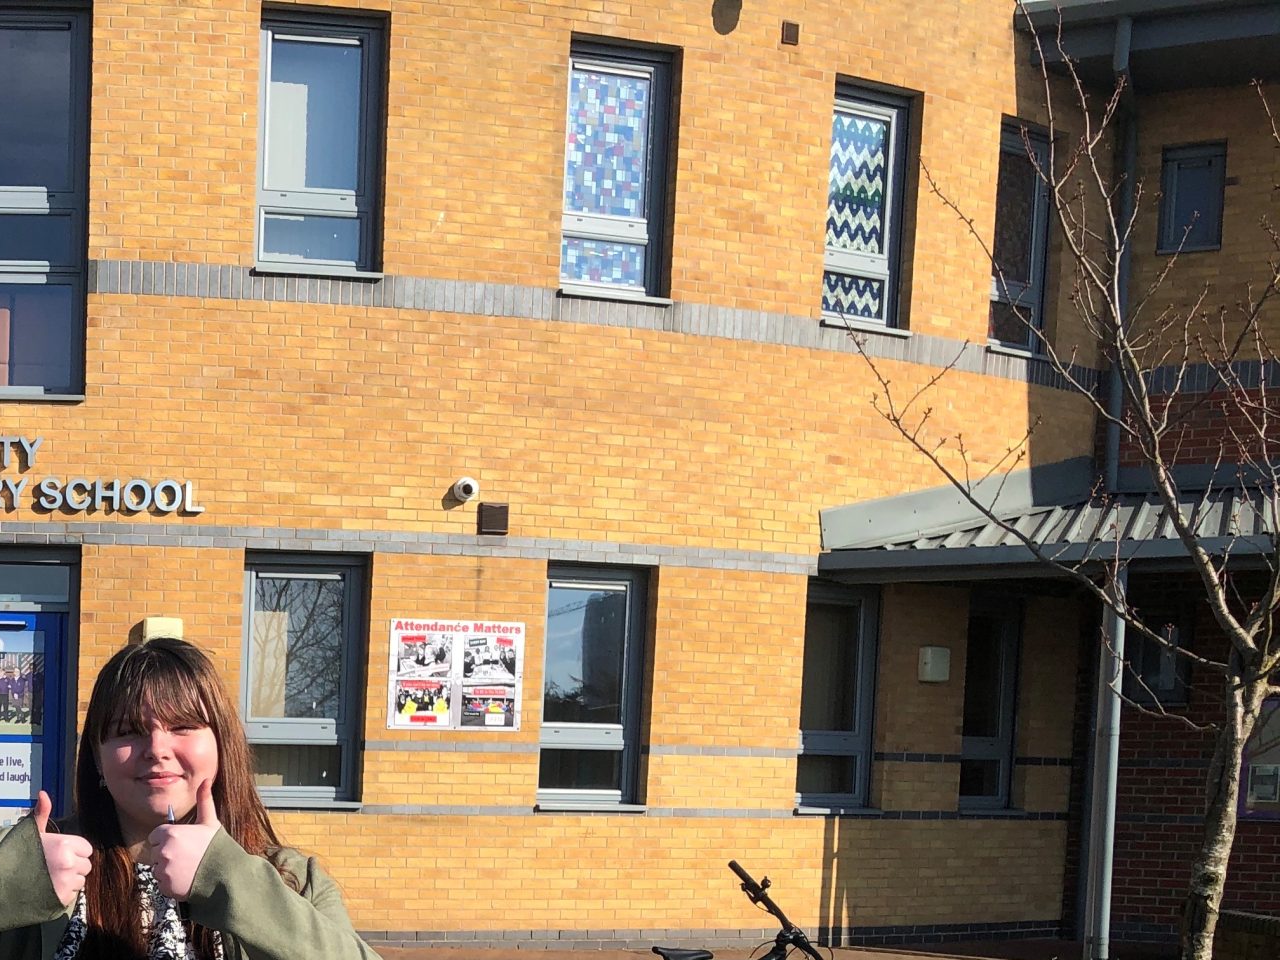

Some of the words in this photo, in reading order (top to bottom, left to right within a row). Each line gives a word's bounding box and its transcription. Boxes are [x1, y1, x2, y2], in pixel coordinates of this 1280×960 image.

[39, 478, 206, 513] SCHOOL
[394, 620, 470, 633] Attendance
[473, 623, 522, 635] Matters
[6, 756, 25, 769] live,
